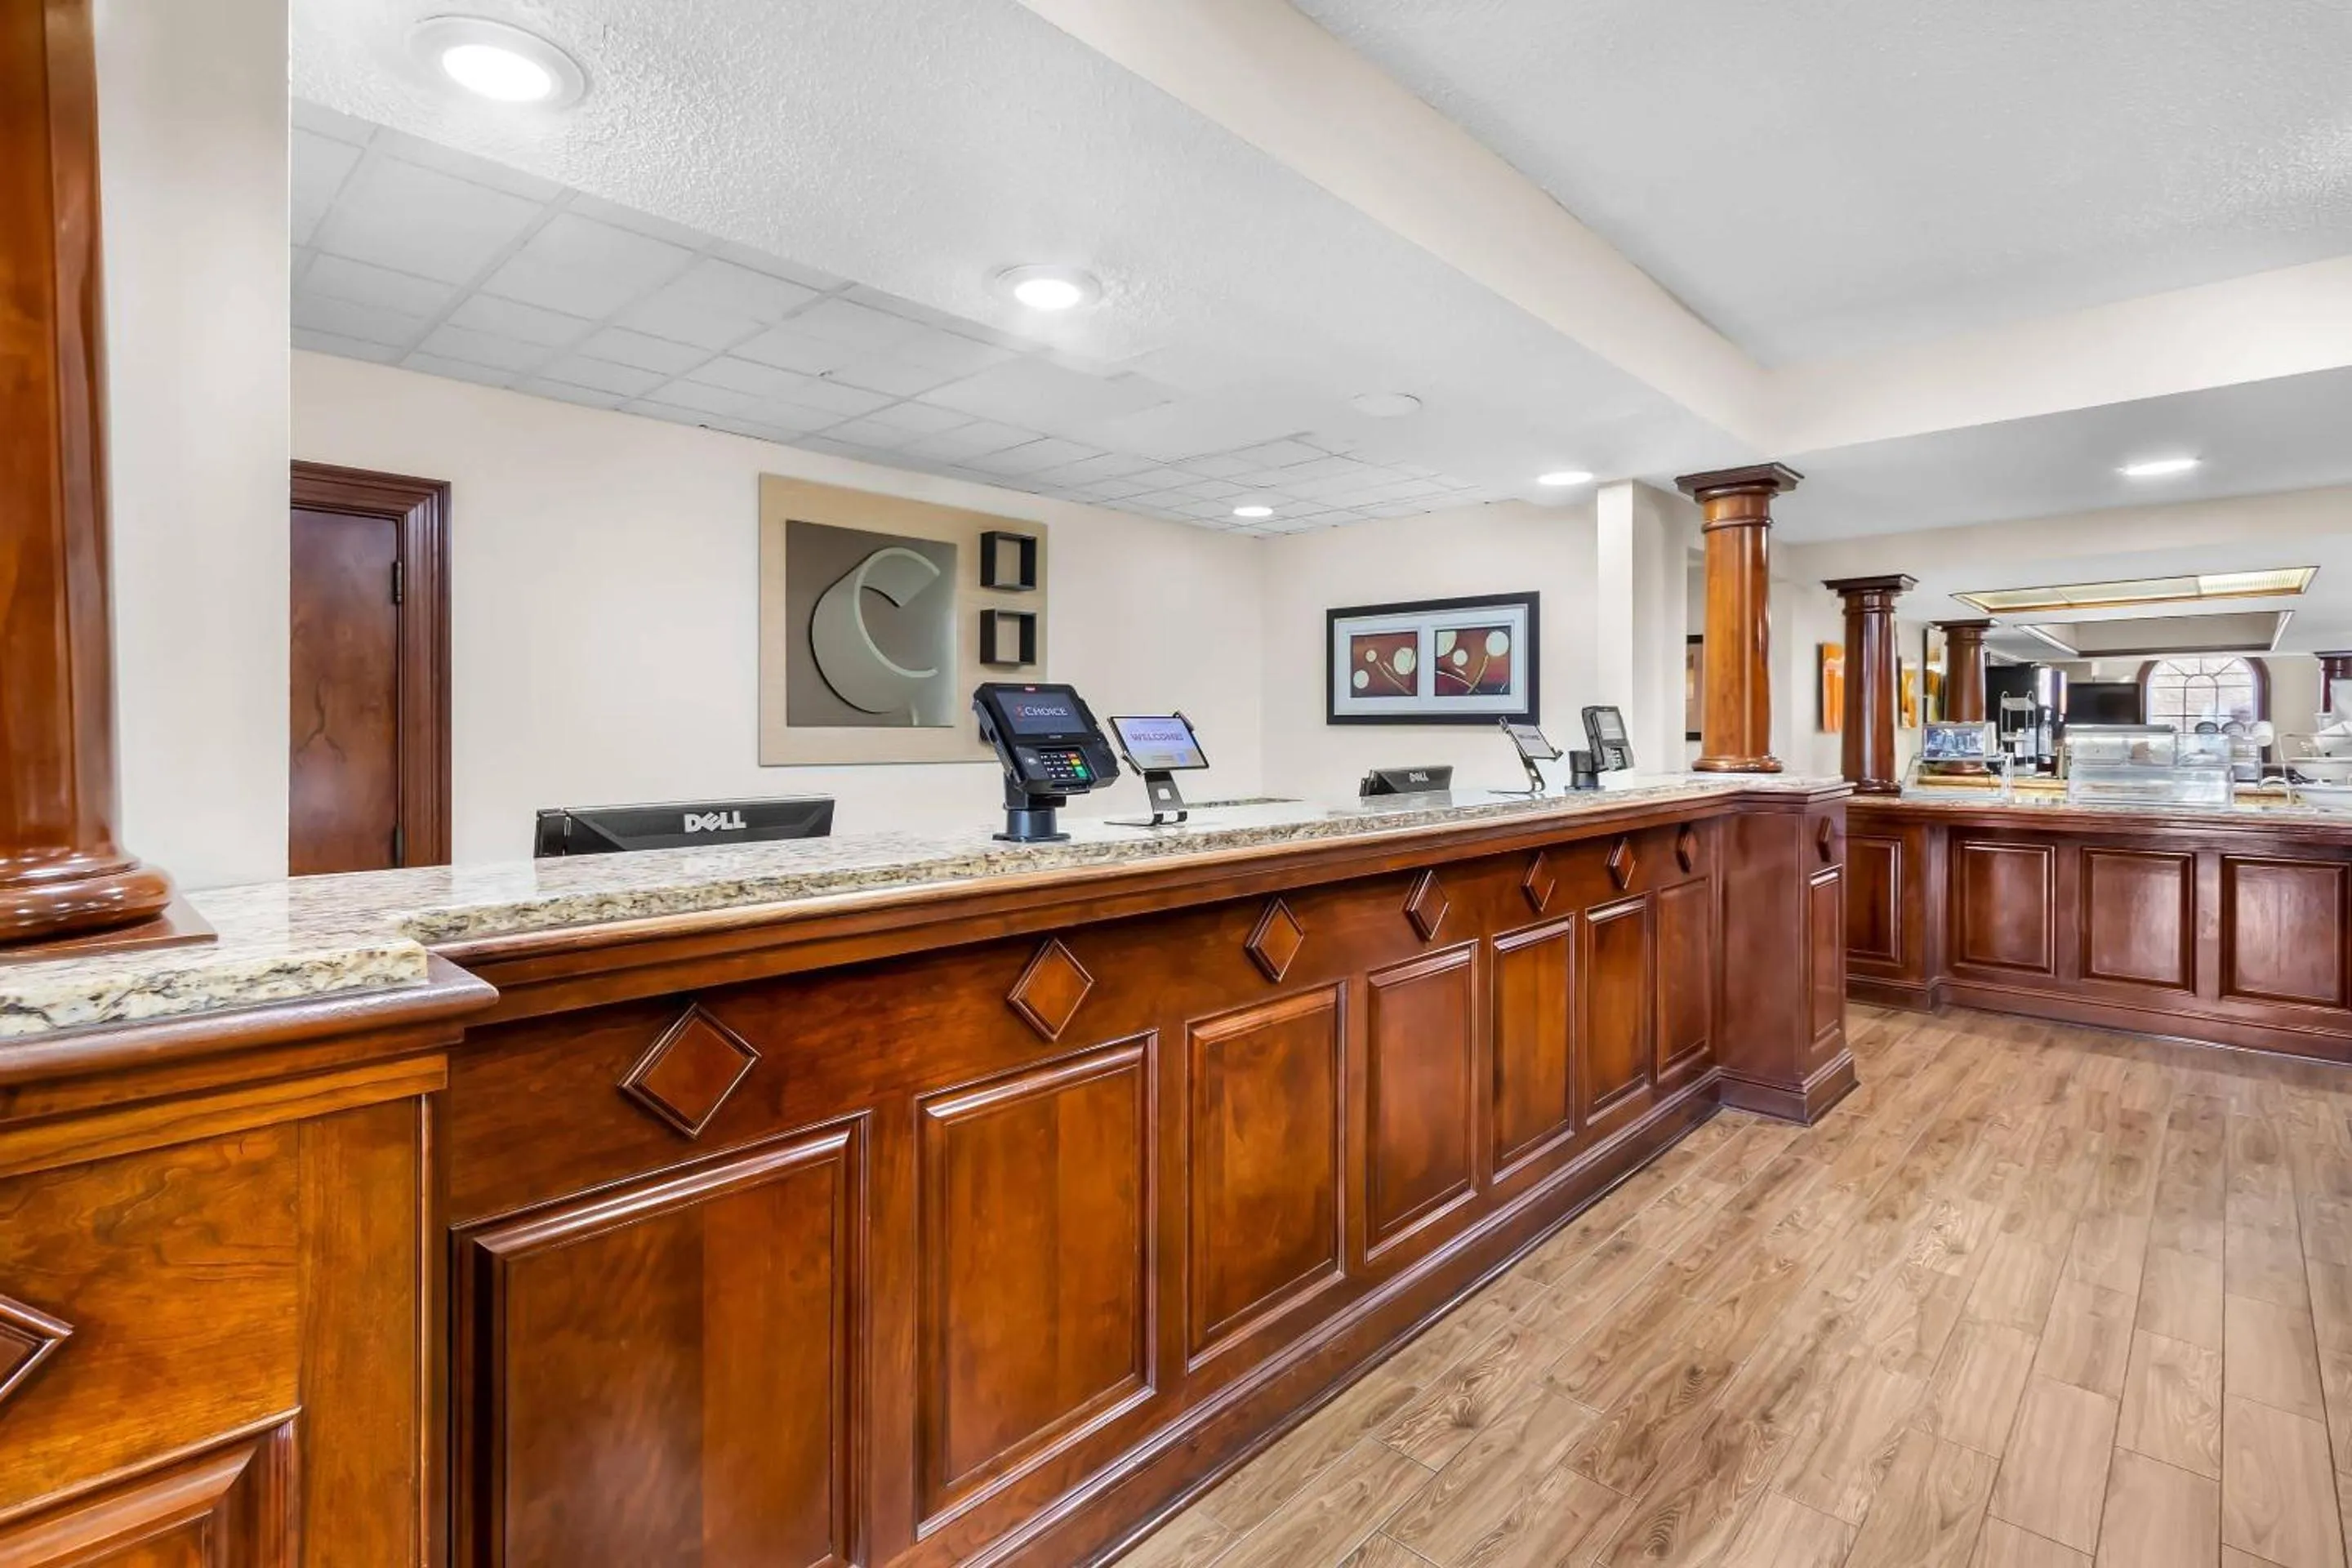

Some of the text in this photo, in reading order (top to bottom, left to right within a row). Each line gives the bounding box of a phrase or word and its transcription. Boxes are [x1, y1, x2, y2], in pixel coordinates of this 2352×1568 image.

[1025, 706, 1068, 716] CHOICE
[1129, 732, 1184, 742] WELCOME
[684, 810, 746, 832] DELL
